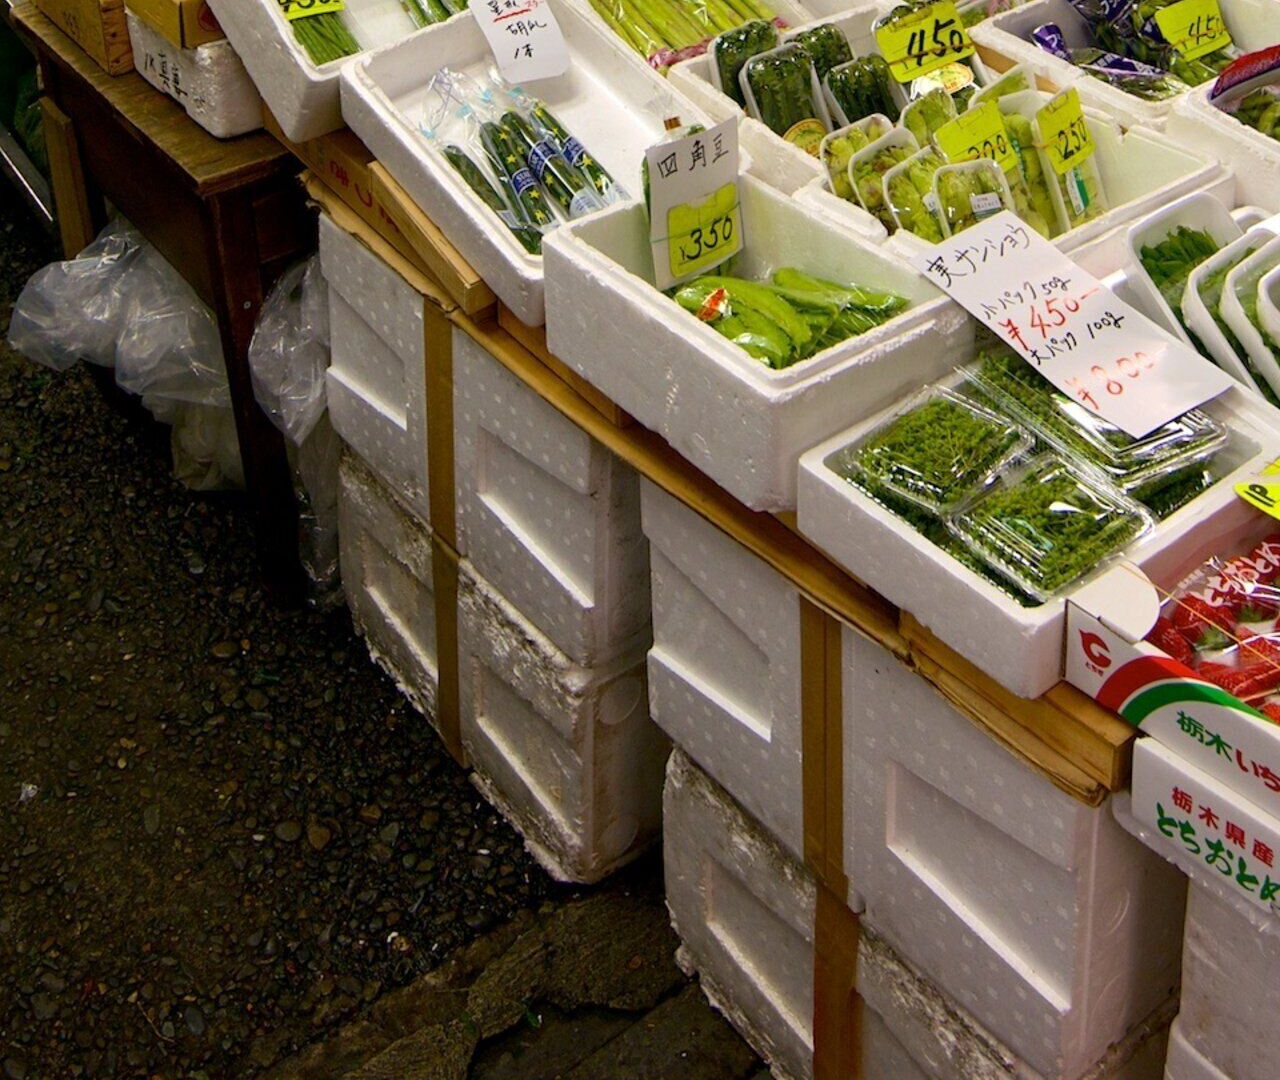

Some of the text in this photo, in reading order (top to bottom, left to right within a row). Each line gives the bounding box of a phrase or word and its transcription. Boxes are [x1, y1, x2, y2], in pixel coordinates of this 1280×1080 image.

[906, 14, 967, 68] 450
[656, 132, 730, 180] 四角豆
[1170, 785, 1275, 869] 栃木県産
